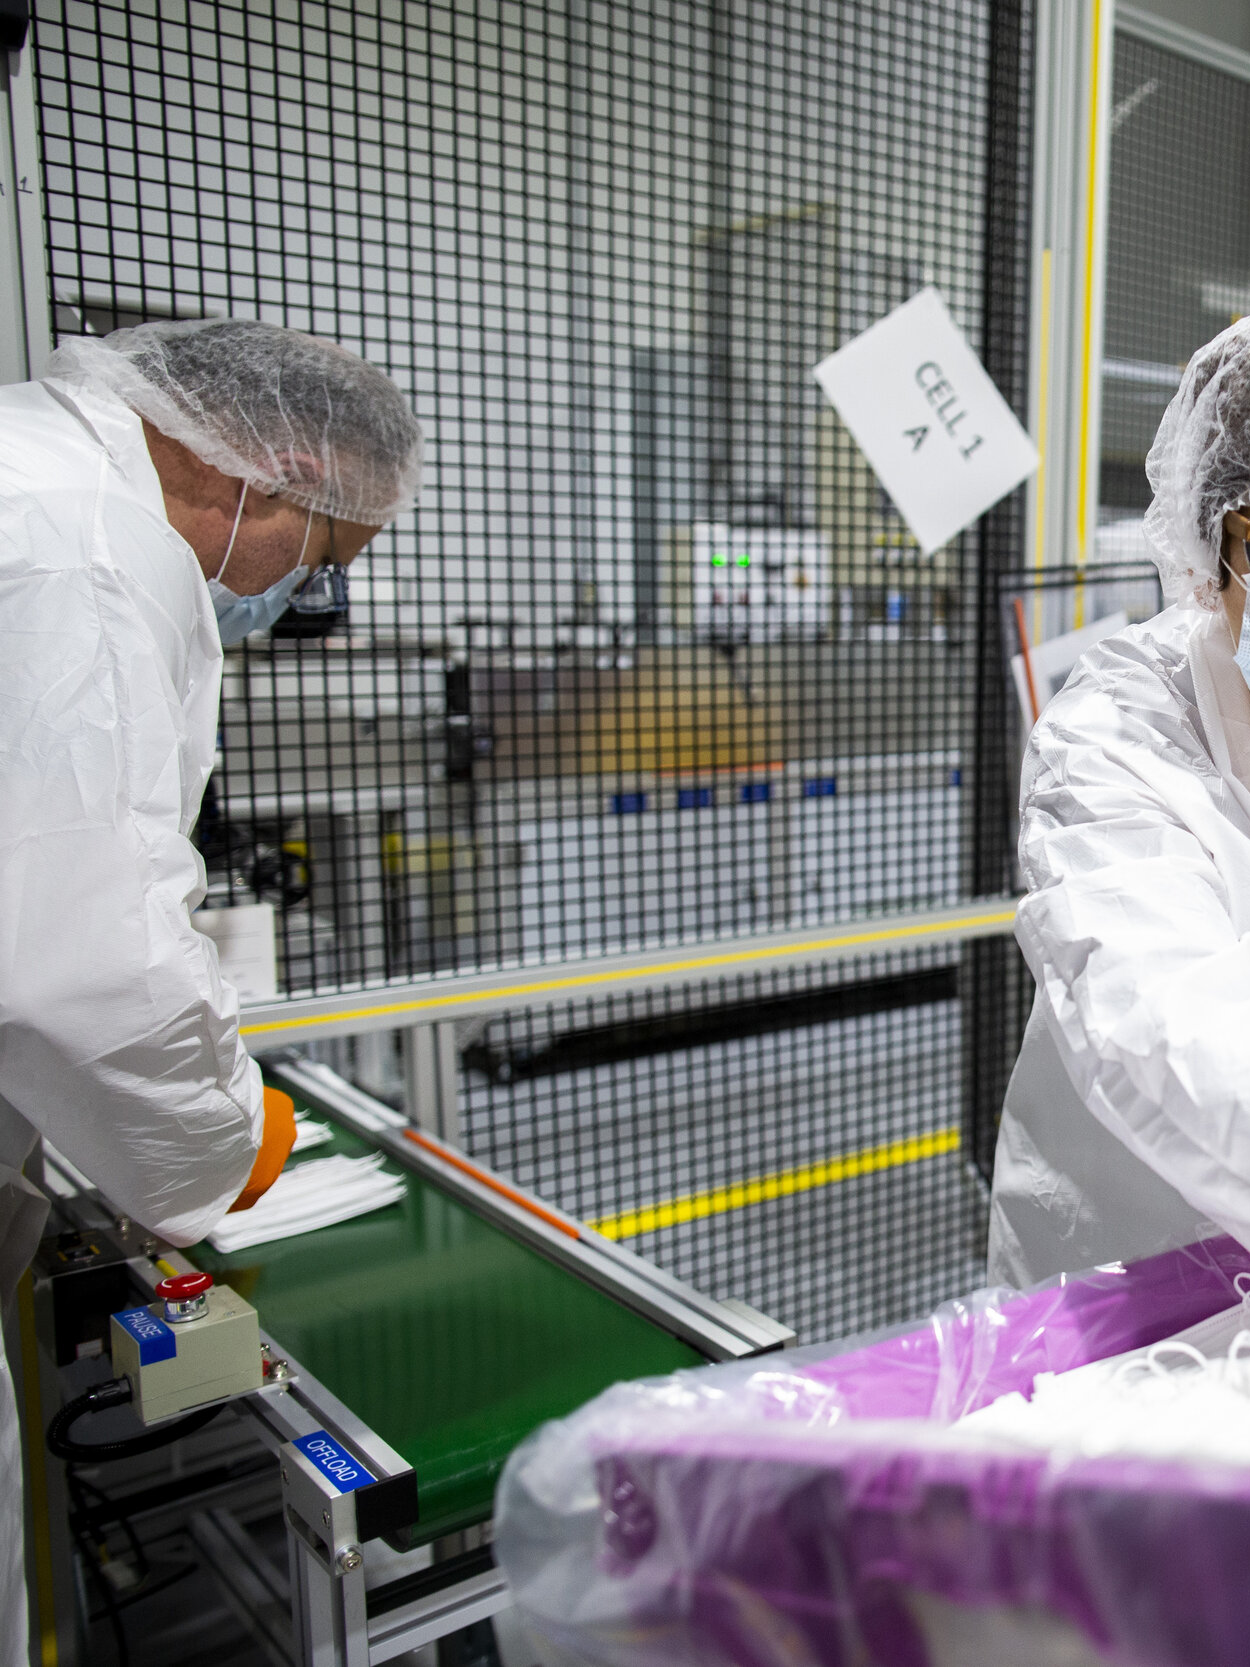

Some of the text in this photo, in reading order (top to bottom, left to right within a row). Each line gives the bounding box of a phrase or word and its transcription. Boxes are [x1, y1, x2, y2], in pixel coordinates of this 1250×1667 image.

[915, 361, 985, 461] CELL 1
[902, 425, 930, 452] A
[124, 1311, 163, 1338] PAUSE
[306, 1439, 358, 1482] OFFLOAD
